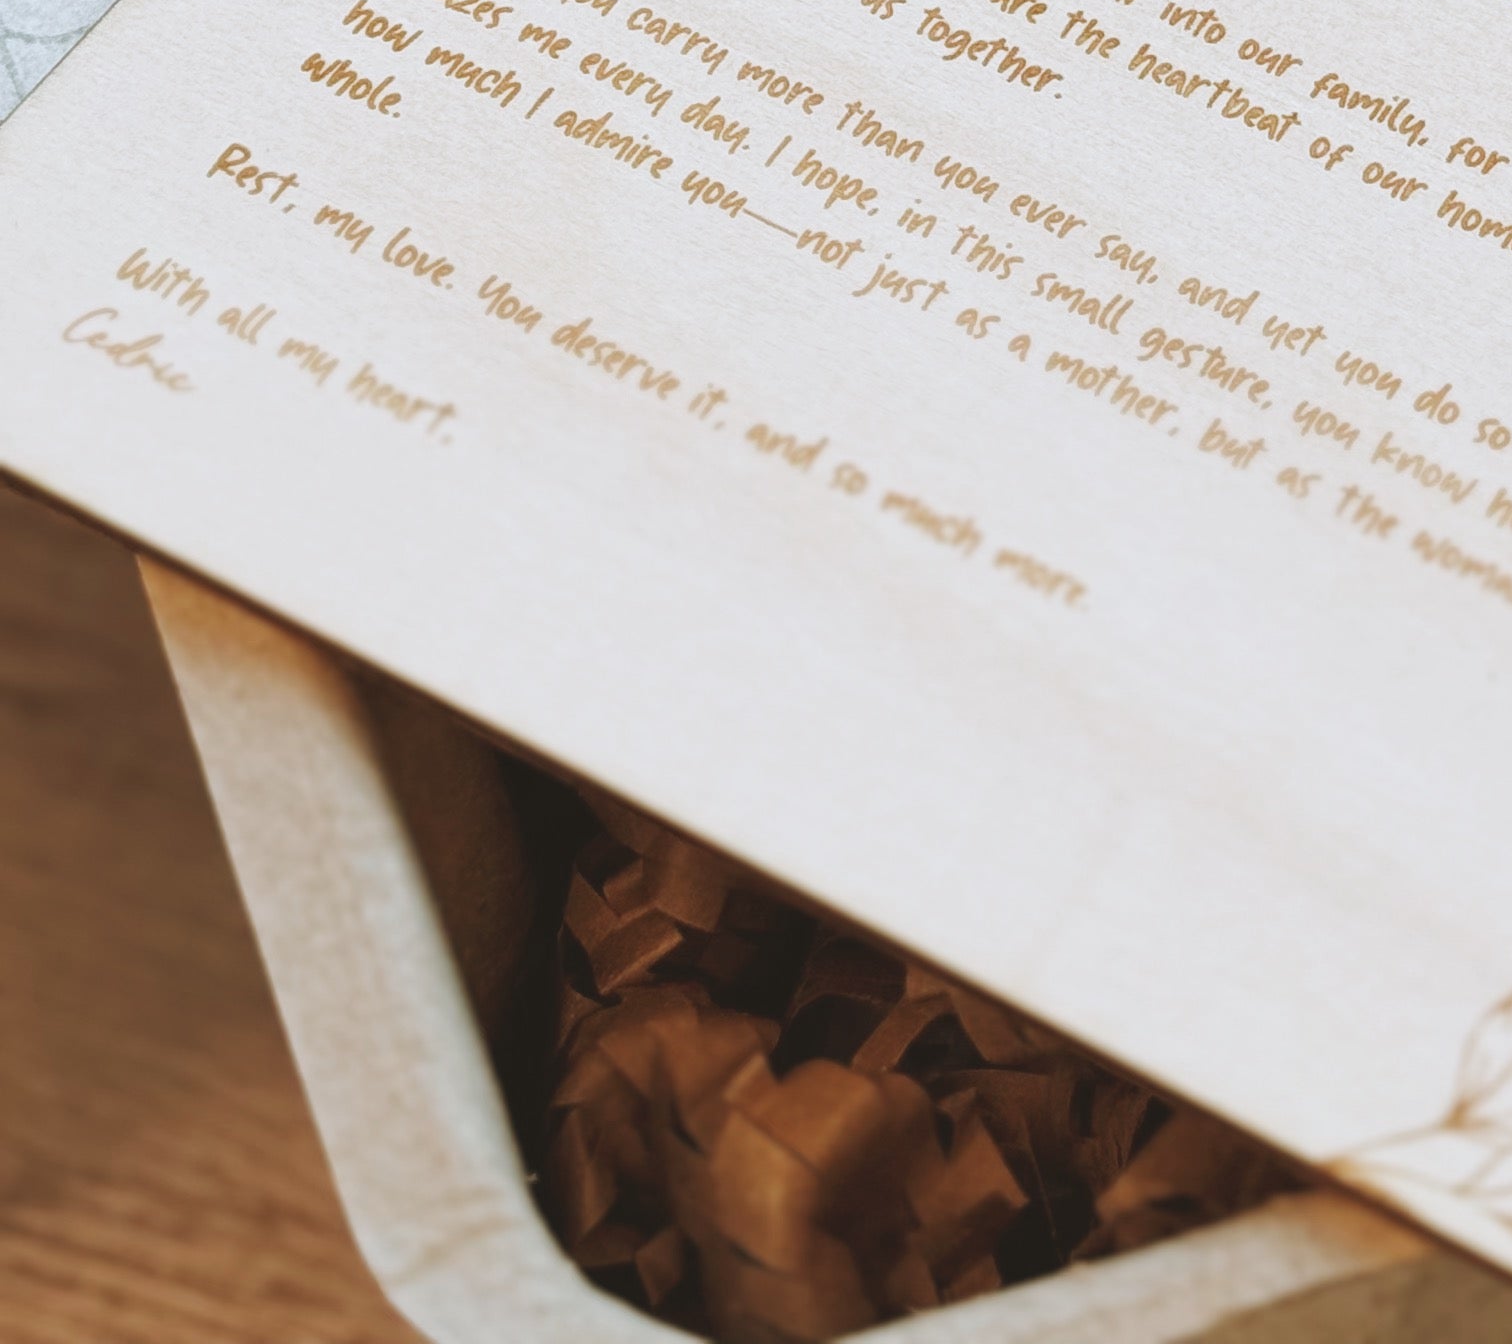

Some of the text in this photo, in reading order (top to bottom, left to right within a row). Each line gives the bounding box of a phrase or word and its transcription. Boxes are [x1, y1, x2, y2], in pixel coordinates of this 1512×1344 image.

[299, 52, 401, 117] whole.
[917, 6, 1062, 99] together.
[1059, 10, 1120, 59] the
[1127, 42, 1301, 141] heartbeat
[1308, 136, 1355, 170] of
[1361, 161, 1428, 201] our
[1237, 37, 1302, 77] our
[1311, 71, 1428, 146] family,
[1445, 136, 1510, 175] for
[425, 45, 521, 108] much
[524, 87, 554, 119] I
[553, 108, 672, 179] admire
[853, 252, 948, 309] just
[954, 307, 999, 339] as
[1007, 332, 1031, 362] a
[1198, 419, 1265, 468] but
[1275, 466, 1319, 499] as
[1337, 484, 1399, 538] the
[518, 23, 571, 59] me
[579, 52, 672, 116] every
[680, 96, 749, 154] day.
[765, 135, 792, 165] I
[792, 149, 878, 215] hope,
[898, 199, 937, 236] in
[952, 225, 1023, 280] this
[1032, 272, 1133, 335] small
[1291, 401, 1359, 448] you
[1371, 432, 1475, 504] know
[626, 7, 728, 74] carry
[736, 60, 825, 115] more
[837, 99, 925, 162] than
[933, 155, 999, 202] you
[1009, 193, 1086, 239] ever
[1095, 233, 1158, 284] say,
[1177, 277, 1260, 325] and
[1262, 315, 1326, 354] yet
[1334, 351, 1402, 398] you
[1414, 383, 1462, 424] do
[1475, 417, 1512, 452] so
[63, 307, 195, 391] Cedric
[115, 248, 209, 315] With
[218, 305, 275, 344] all
[278, 338, 338, 385] my
[208, 142, 298, 212] Rest,
[313, 204, 373, 253] my
[382, 227, 455, 287] love.
[477, 275, 542, 332] You
[550, 317, 680, 399] deserve
[744, 421, 828, 471] and
[829, 461, 868, 495] so
[880, 489, 982, 555] much
